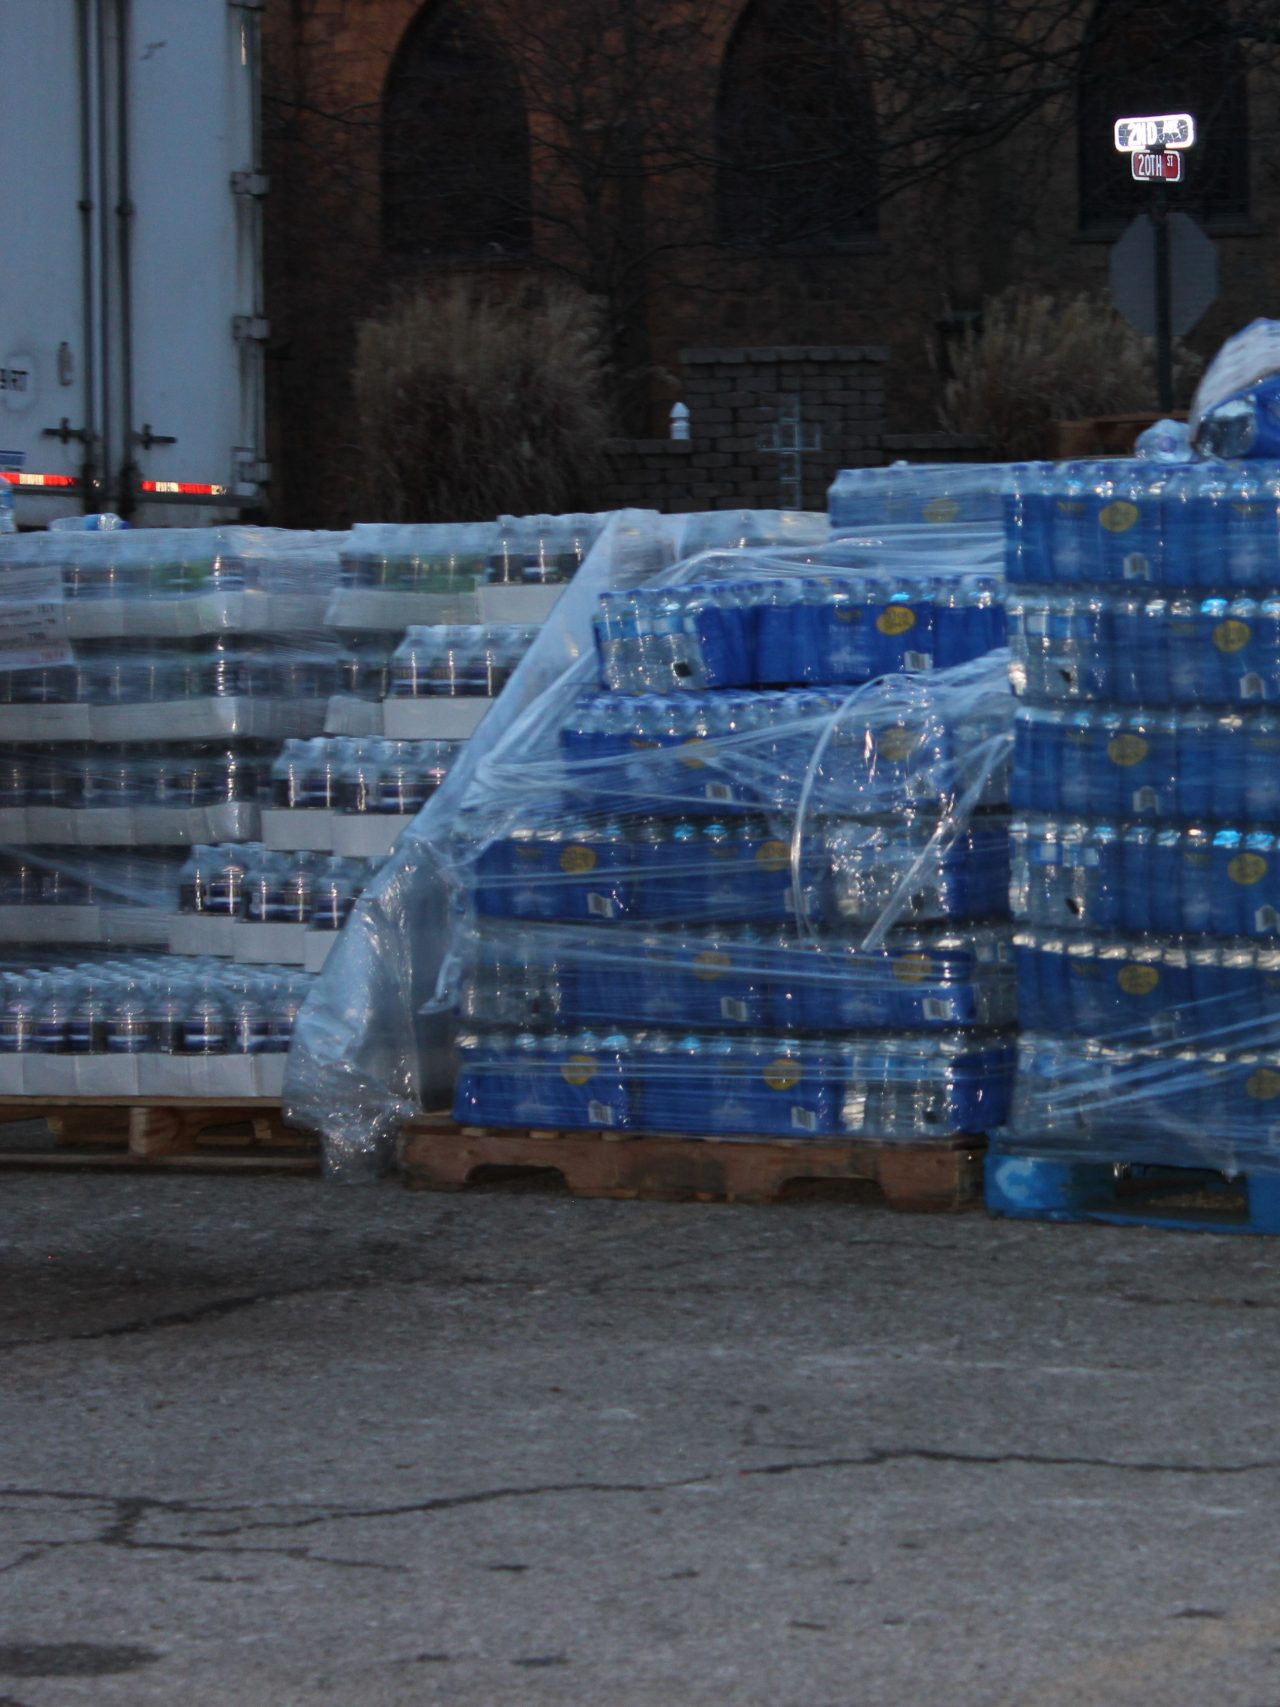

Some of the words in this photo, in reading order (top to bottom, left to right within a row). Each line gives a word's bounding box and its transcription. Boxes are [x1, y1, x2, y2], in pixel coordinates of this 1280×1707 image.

[1127, 121, 1157, 145] 2ND
[1138, 154, 1162, 176] 20TH
[1166, 155, 1174, 167] ST
